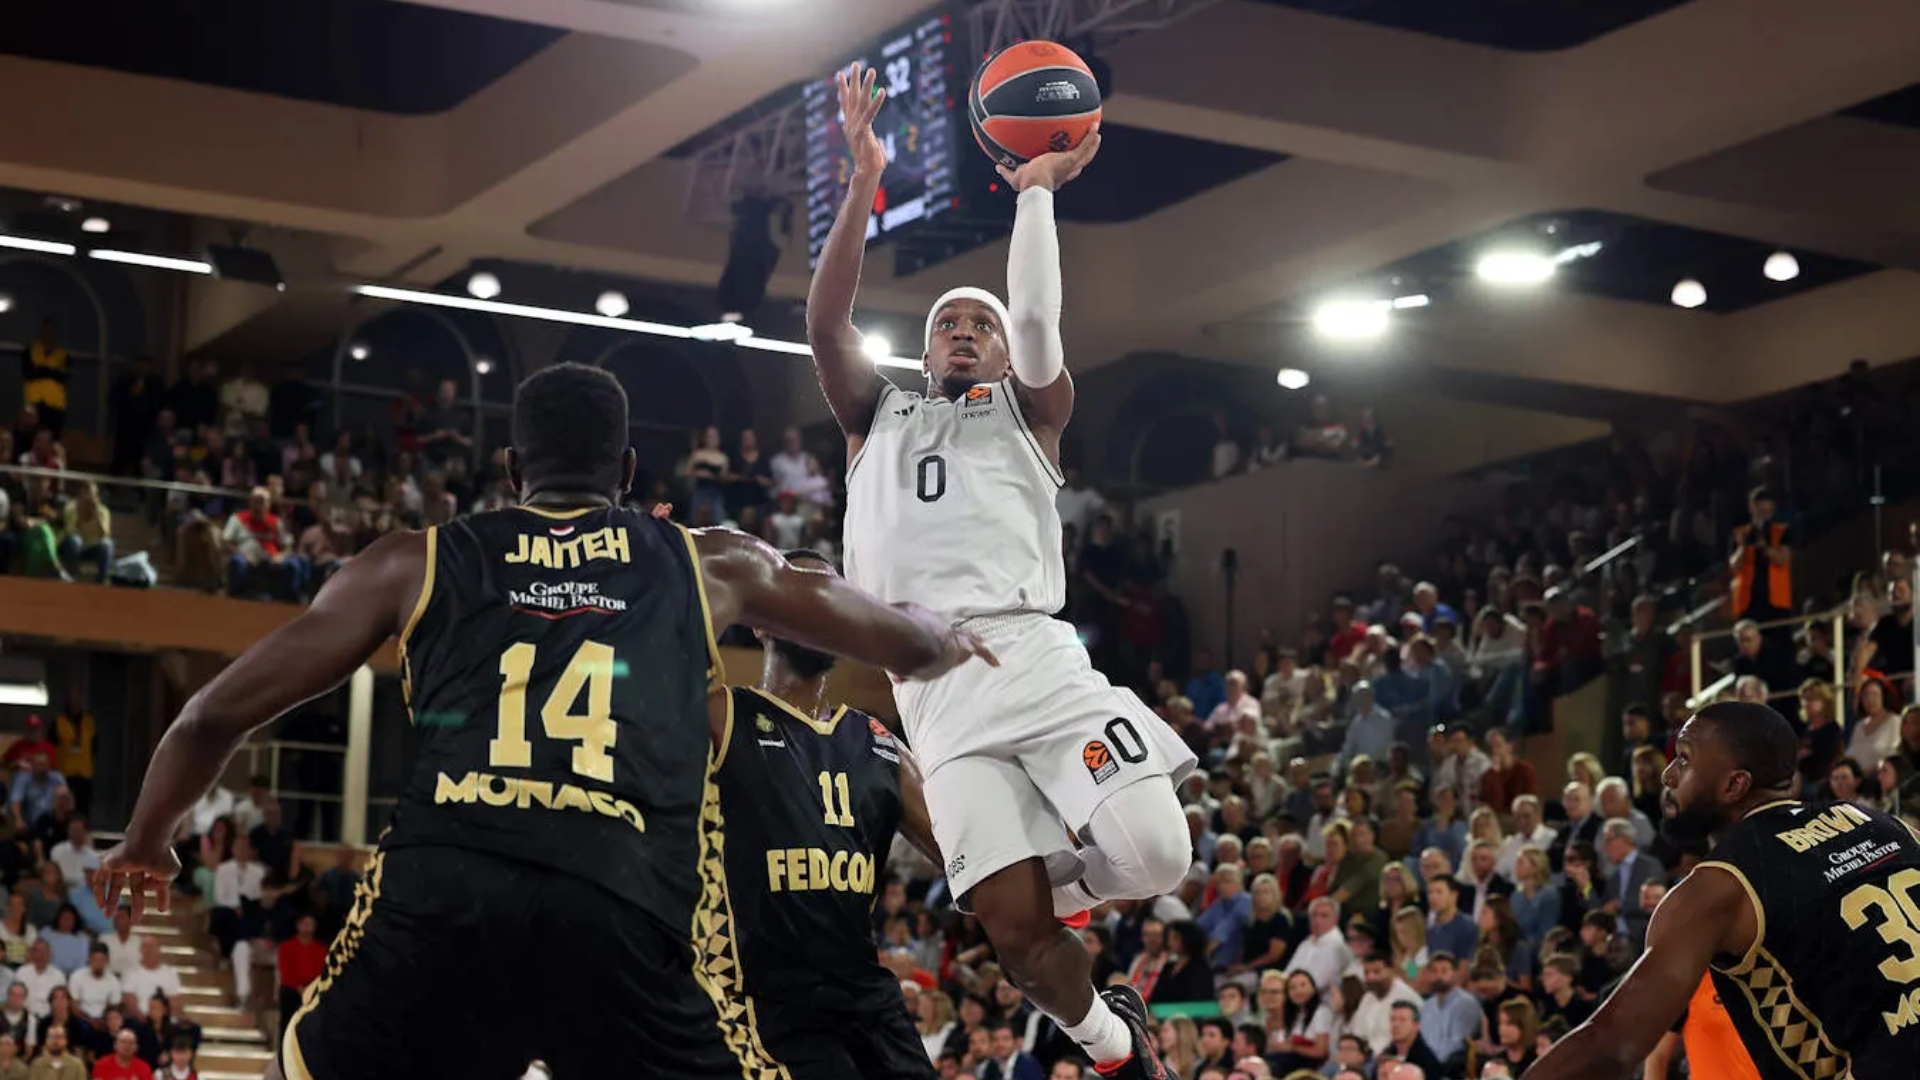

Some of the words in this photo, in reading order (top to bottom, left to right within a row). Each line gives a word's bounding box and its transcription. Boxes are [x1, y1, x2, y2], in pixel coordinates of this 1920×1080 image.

[917, 455, 947, 503] 0
[505, 526, 631, 569] JAITEH
[489, 639, 617, 783] 14
[1104, 716, 1148, 764] 0
[434, 772, 646, 834] MONACO
[818, 771, 855, 827] 11
[1775, 803, 1873, 853] BROWN
